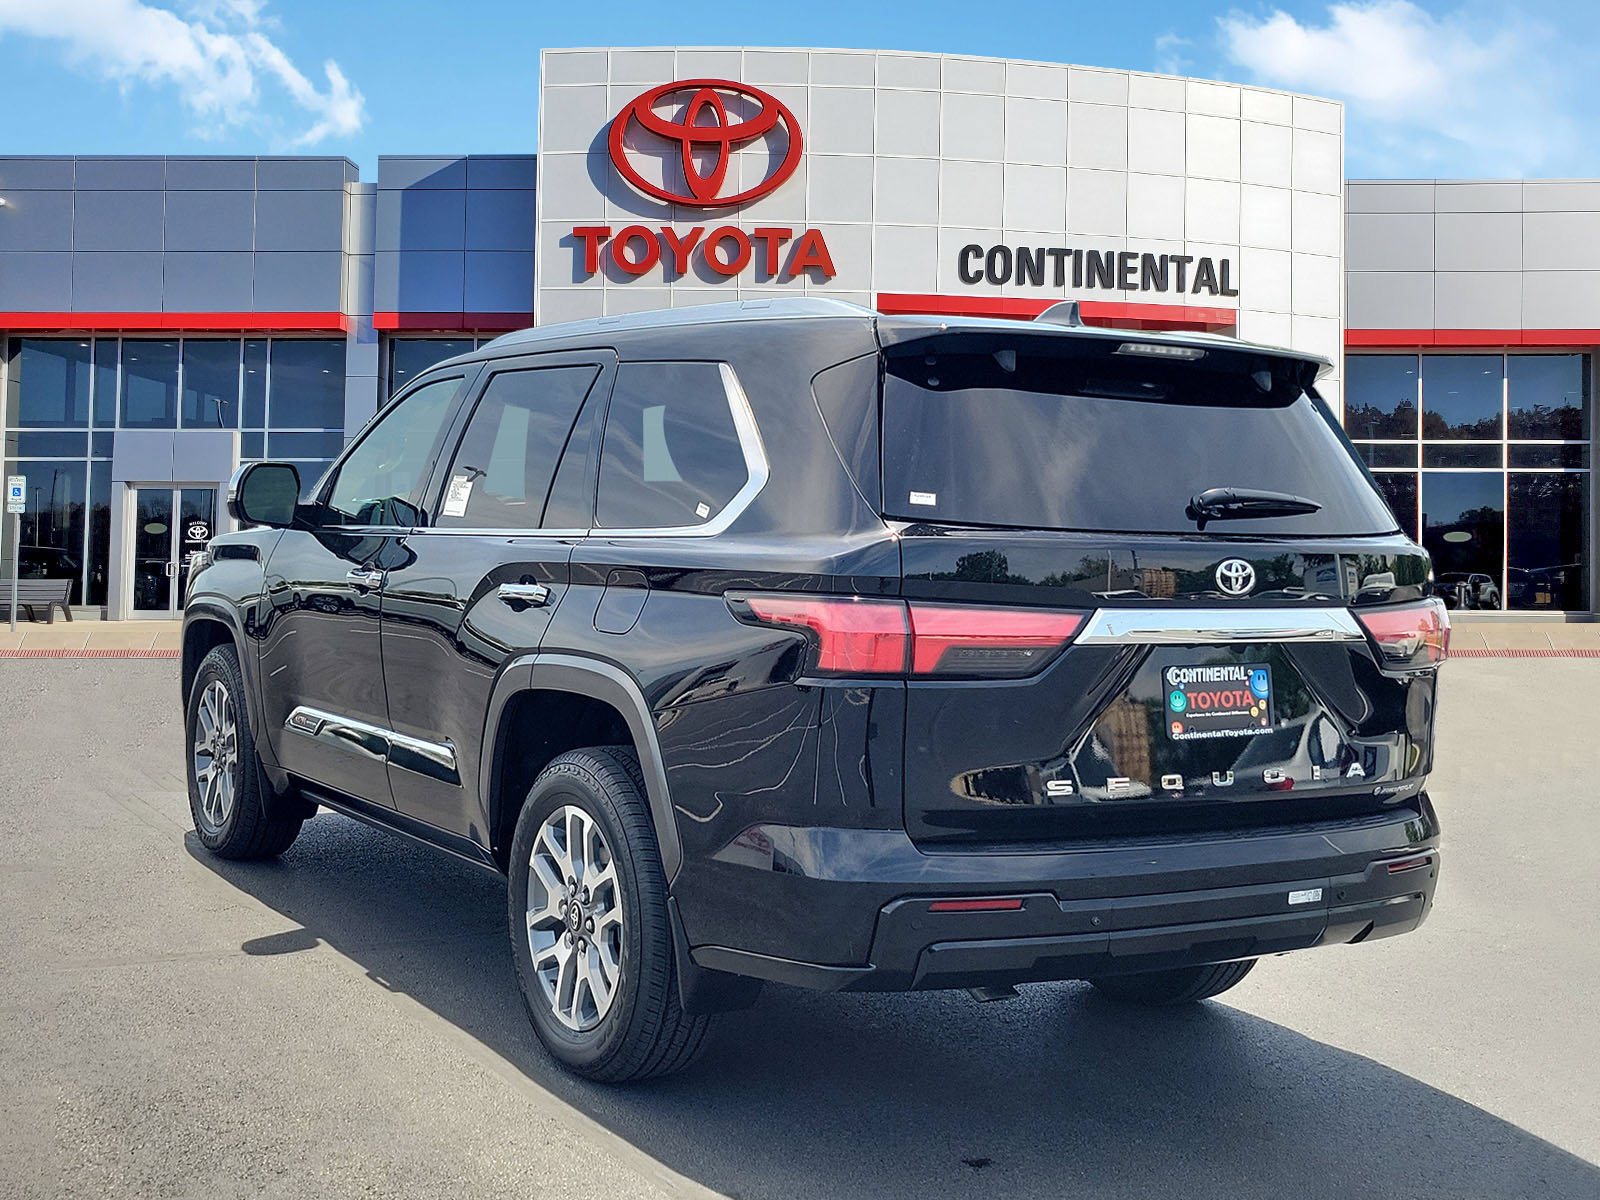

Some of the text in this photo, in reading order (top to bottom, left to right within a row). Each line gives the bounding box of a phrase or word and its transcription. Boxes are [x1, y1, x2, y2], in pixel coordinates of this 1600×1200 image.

[572, 225, 837, 277] TOYOTA
[958, 244, 1239, 296] CONTINENTAL
[1167, 666, 1248, 685] CONTINENTAL
[1187, 690, 1255, 709] TOYOTA
[1172, 728, 1273, 740] ContinentalToyota.com
[1046, 762, 1367, 797] SEQUOIA
